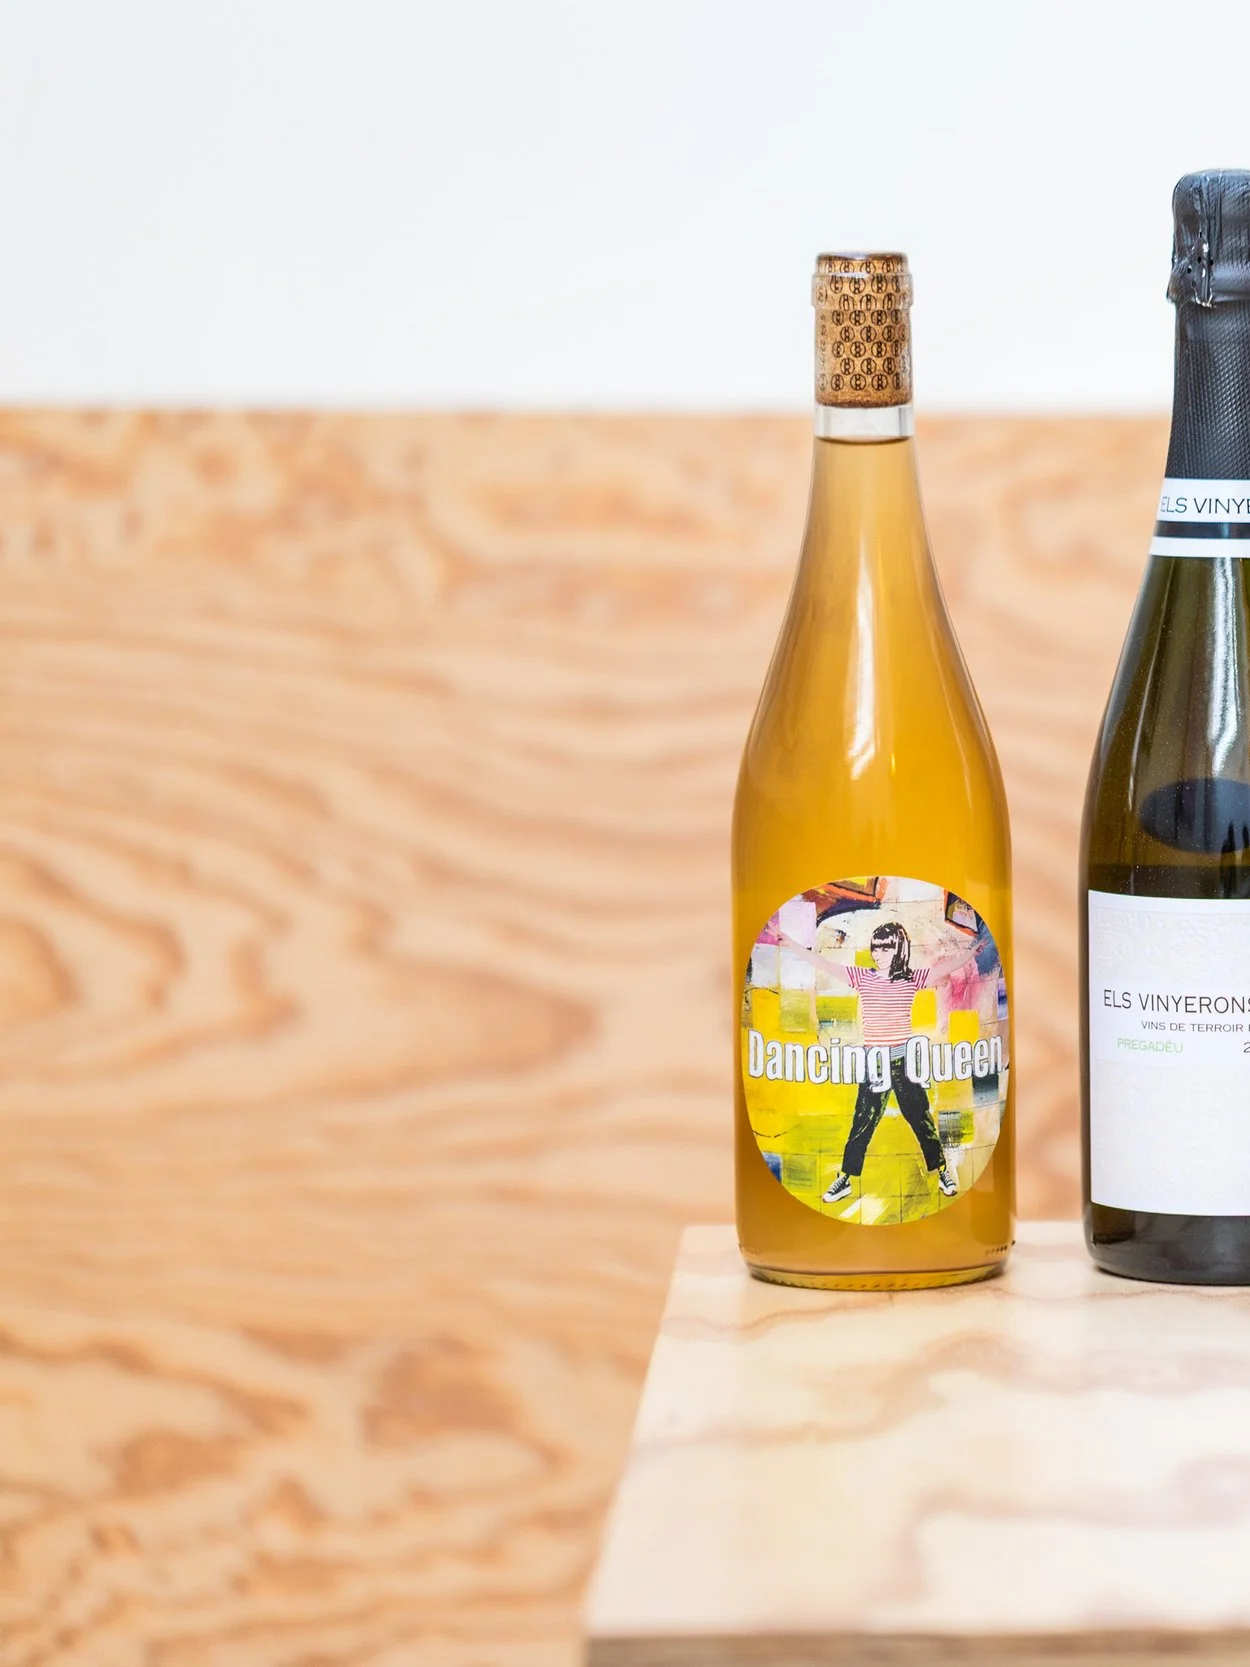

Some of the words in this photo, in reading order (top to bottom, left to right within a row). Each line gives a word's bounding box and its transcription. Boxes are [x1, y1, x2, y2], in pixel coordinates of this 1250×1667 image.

[1160, 496, 1188, 514] ELS
[1103, 989, 1132, 1009] ELS
[1141, 1020, 1167, 1031] VINS
[1169, 1022, 1186, 1032] DE
[1191, 1022, 1244, 1033] TERROIR
[747, 1029, 892, 1093] Dancing
[904, 1034, 1005, 1089] Queen
